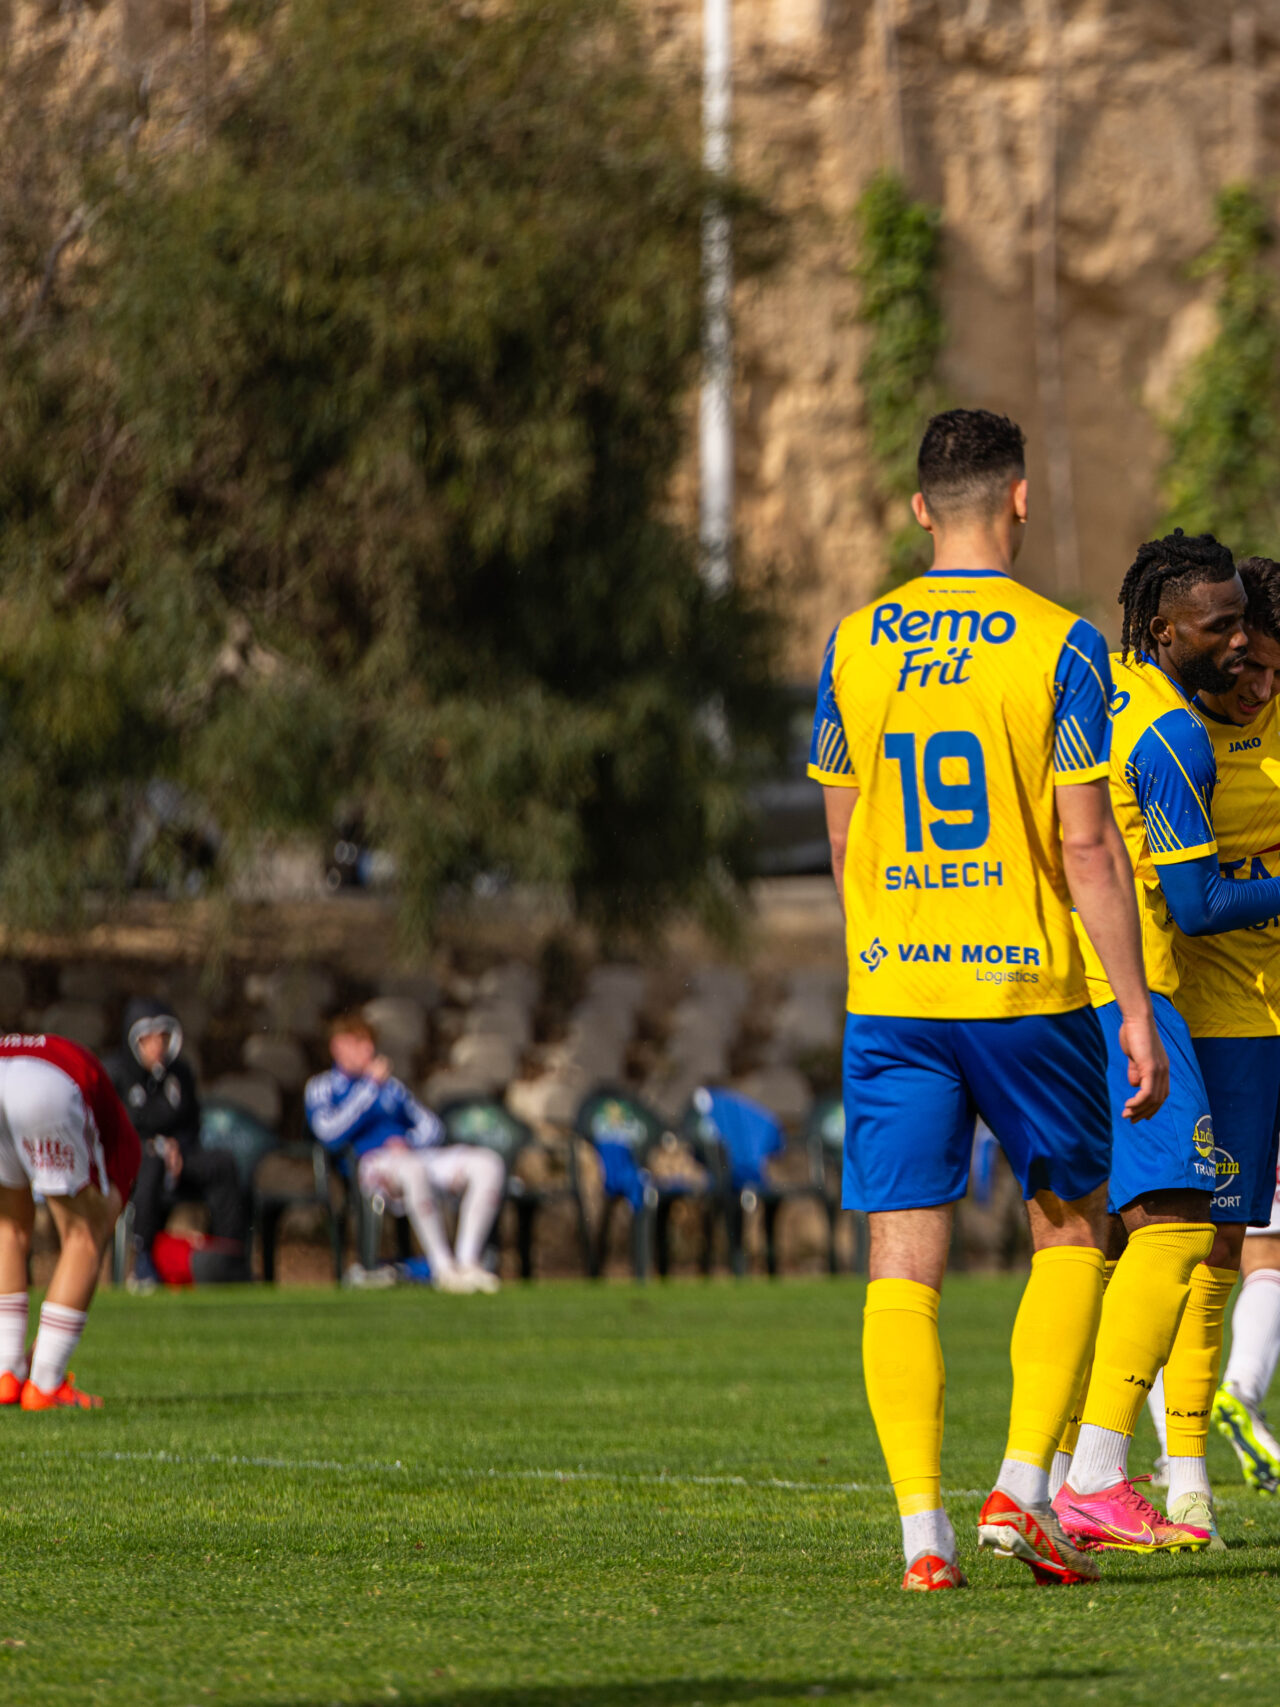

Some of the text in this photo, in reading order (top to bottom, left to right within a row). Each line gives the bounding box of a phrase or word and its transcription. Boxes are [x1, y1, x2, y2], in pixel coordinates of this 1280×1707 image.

[871, 603, 1016, 646] Remo
[897, 646, 974, 692] Frit
[1228, 736, 1262, 753] JAKO
[884, 730, 991, 853] 19
[886, 861, 1003, 891] SALECH
[898, 944, 1040, 965] VAN MOER
[975, 967, 1040, 985] Logistics
[1210, 1195, 1241, 1208] PORT
